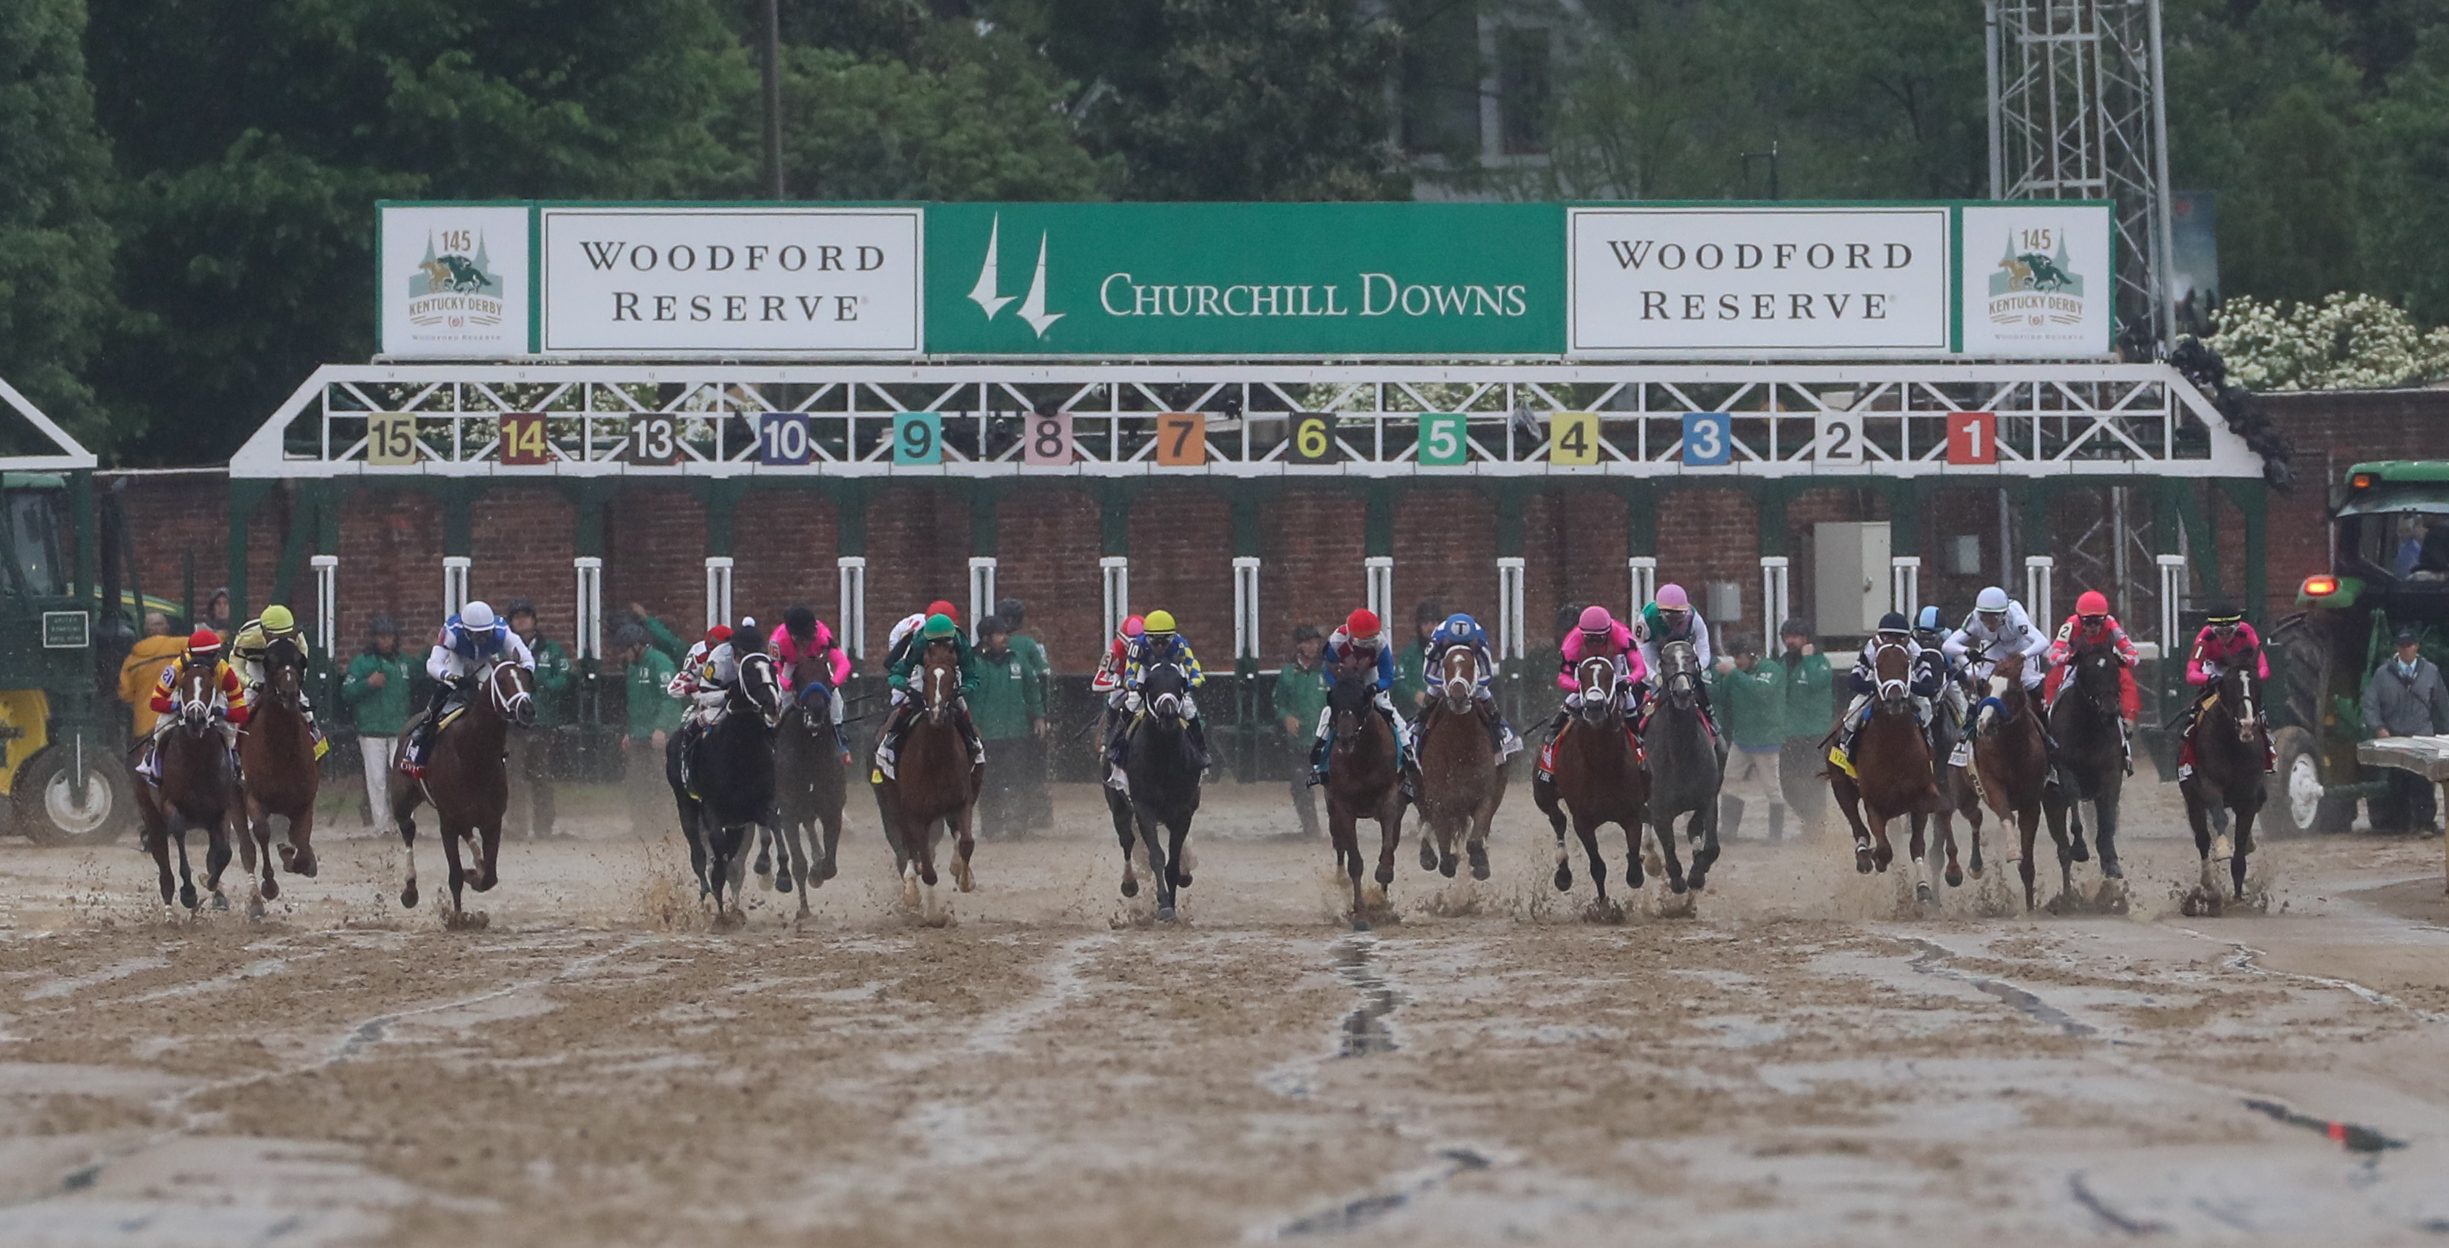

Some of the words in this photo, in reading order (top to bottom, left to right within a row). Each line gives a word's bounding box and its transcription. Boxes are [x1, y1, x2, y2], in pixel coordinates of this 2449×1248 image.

[441, 230, 471, 251] 145
[580, 241, 885, 272] WOODFORD
[1607, 240, 1913, 271] WOODFORD
[2021, 228, 2051, 250] 145
[409, 297, 466, 316] KENTUCKY
[468, 297, 503, 316] DERBY
[1100, 272, 1348, 316] CHURCHILL
[1359, 272, 1526, 316] DOWNS
[1988, 296, 2046, 316] KENTUCKY
[2048, 296, 2084, 315] DERBY
[372, 419, 412, 458] 15
[503, 419, 545, 458] 14
[632, 419, 673, 459] 13
[764, 419, 807, 459] 10
[902, 419, 932, 459] 9
[1034, 418, 1064, 459] 8
[1168, 420, 1195, 458] 7
[1297, 418, 1327, 459] 6
[1428, 419, 1458, 459] 5
[1559, 420, 1589, 458] 4
[1692, 419, 1721, 459] 3
[1825, 421, 1853, 459] 2
[1962, 419, 1981, 458] 1
[1455, 622, 1467, 635] T
[1635, 625, 1643, 638] 8
[2059, 625, 2070, 639] 2
[1128, 642, 1139, 658] 10
[2195, 645, 2203, 660] 1
